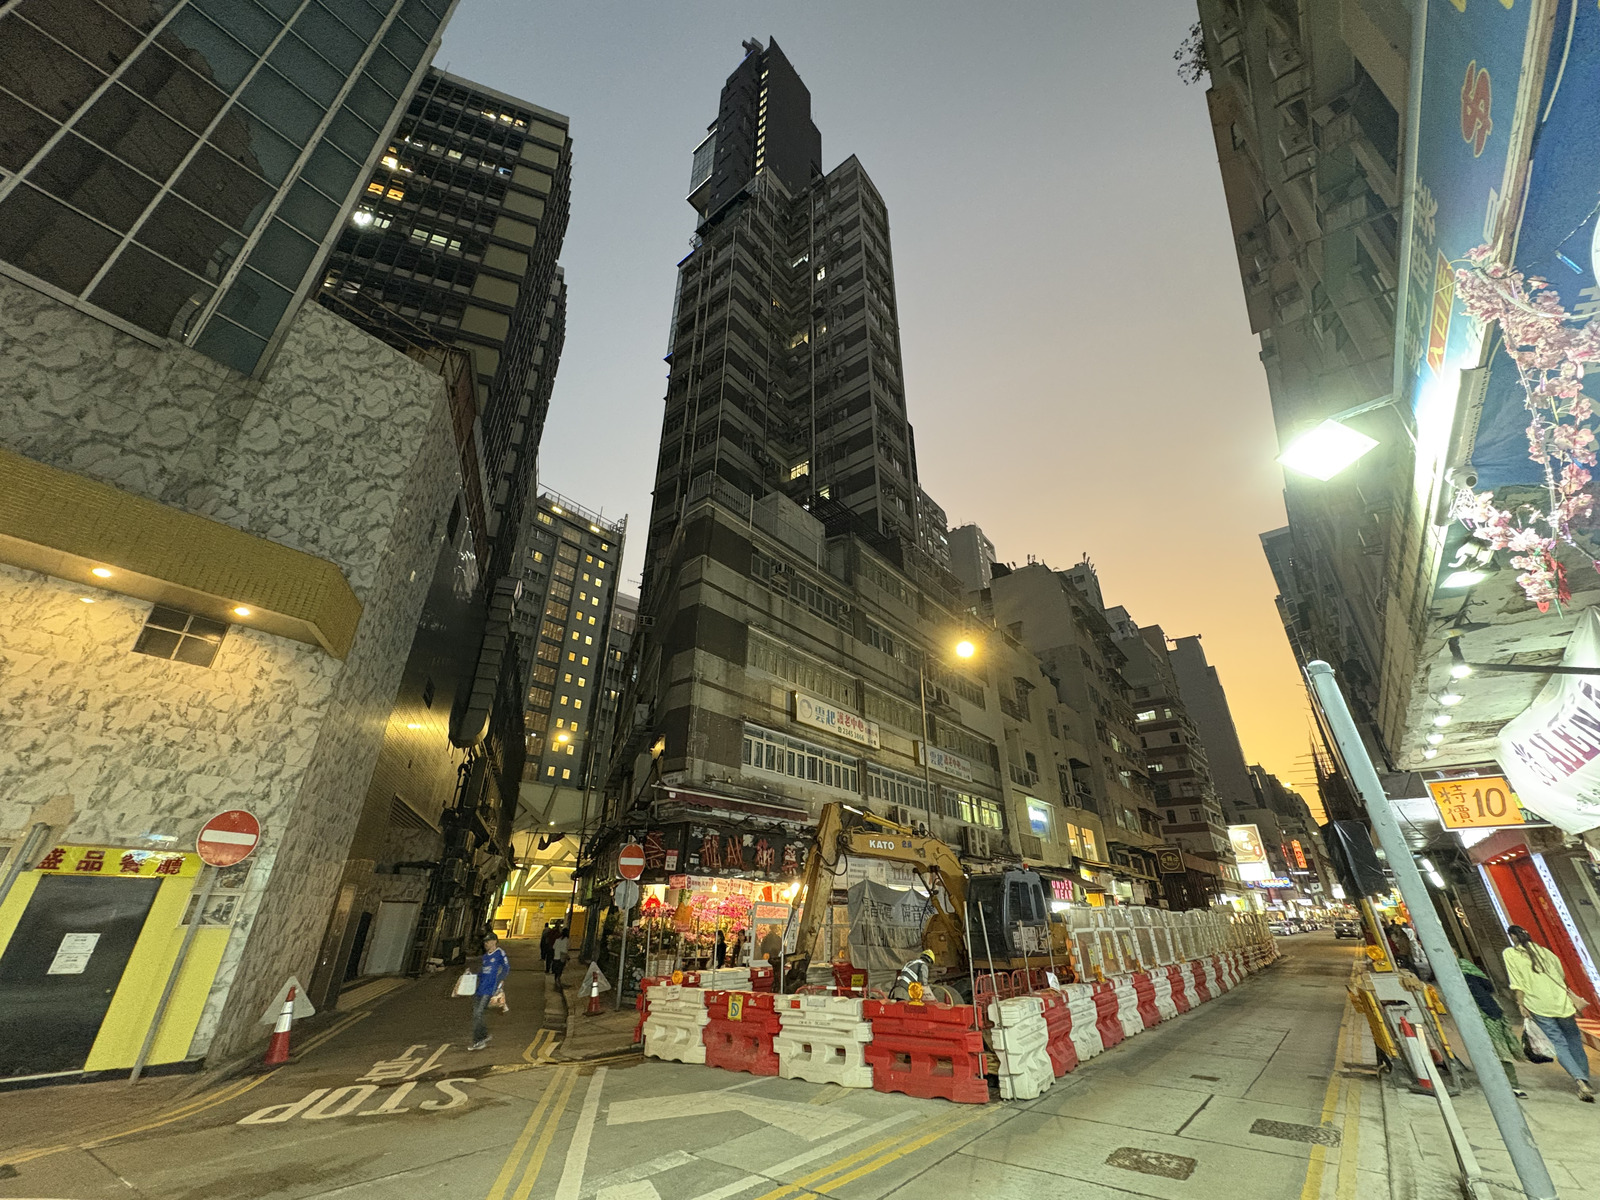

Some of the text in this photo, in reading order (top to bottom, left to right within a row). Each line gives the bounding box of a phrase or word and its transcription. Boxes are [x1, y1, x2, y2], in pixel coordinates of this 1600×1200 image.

[1438, 784, 1474, 823] 特價
[1472, 787, 1507, 818] 10
[869, 839, 895, 850] KATO
[1051, 879, 1074, 891] UNDER
[1054, 889, 1074, 901] WEAR
[355, 1043, 455, 1082] 停
[236, 1077, 477, 1125] STOP
